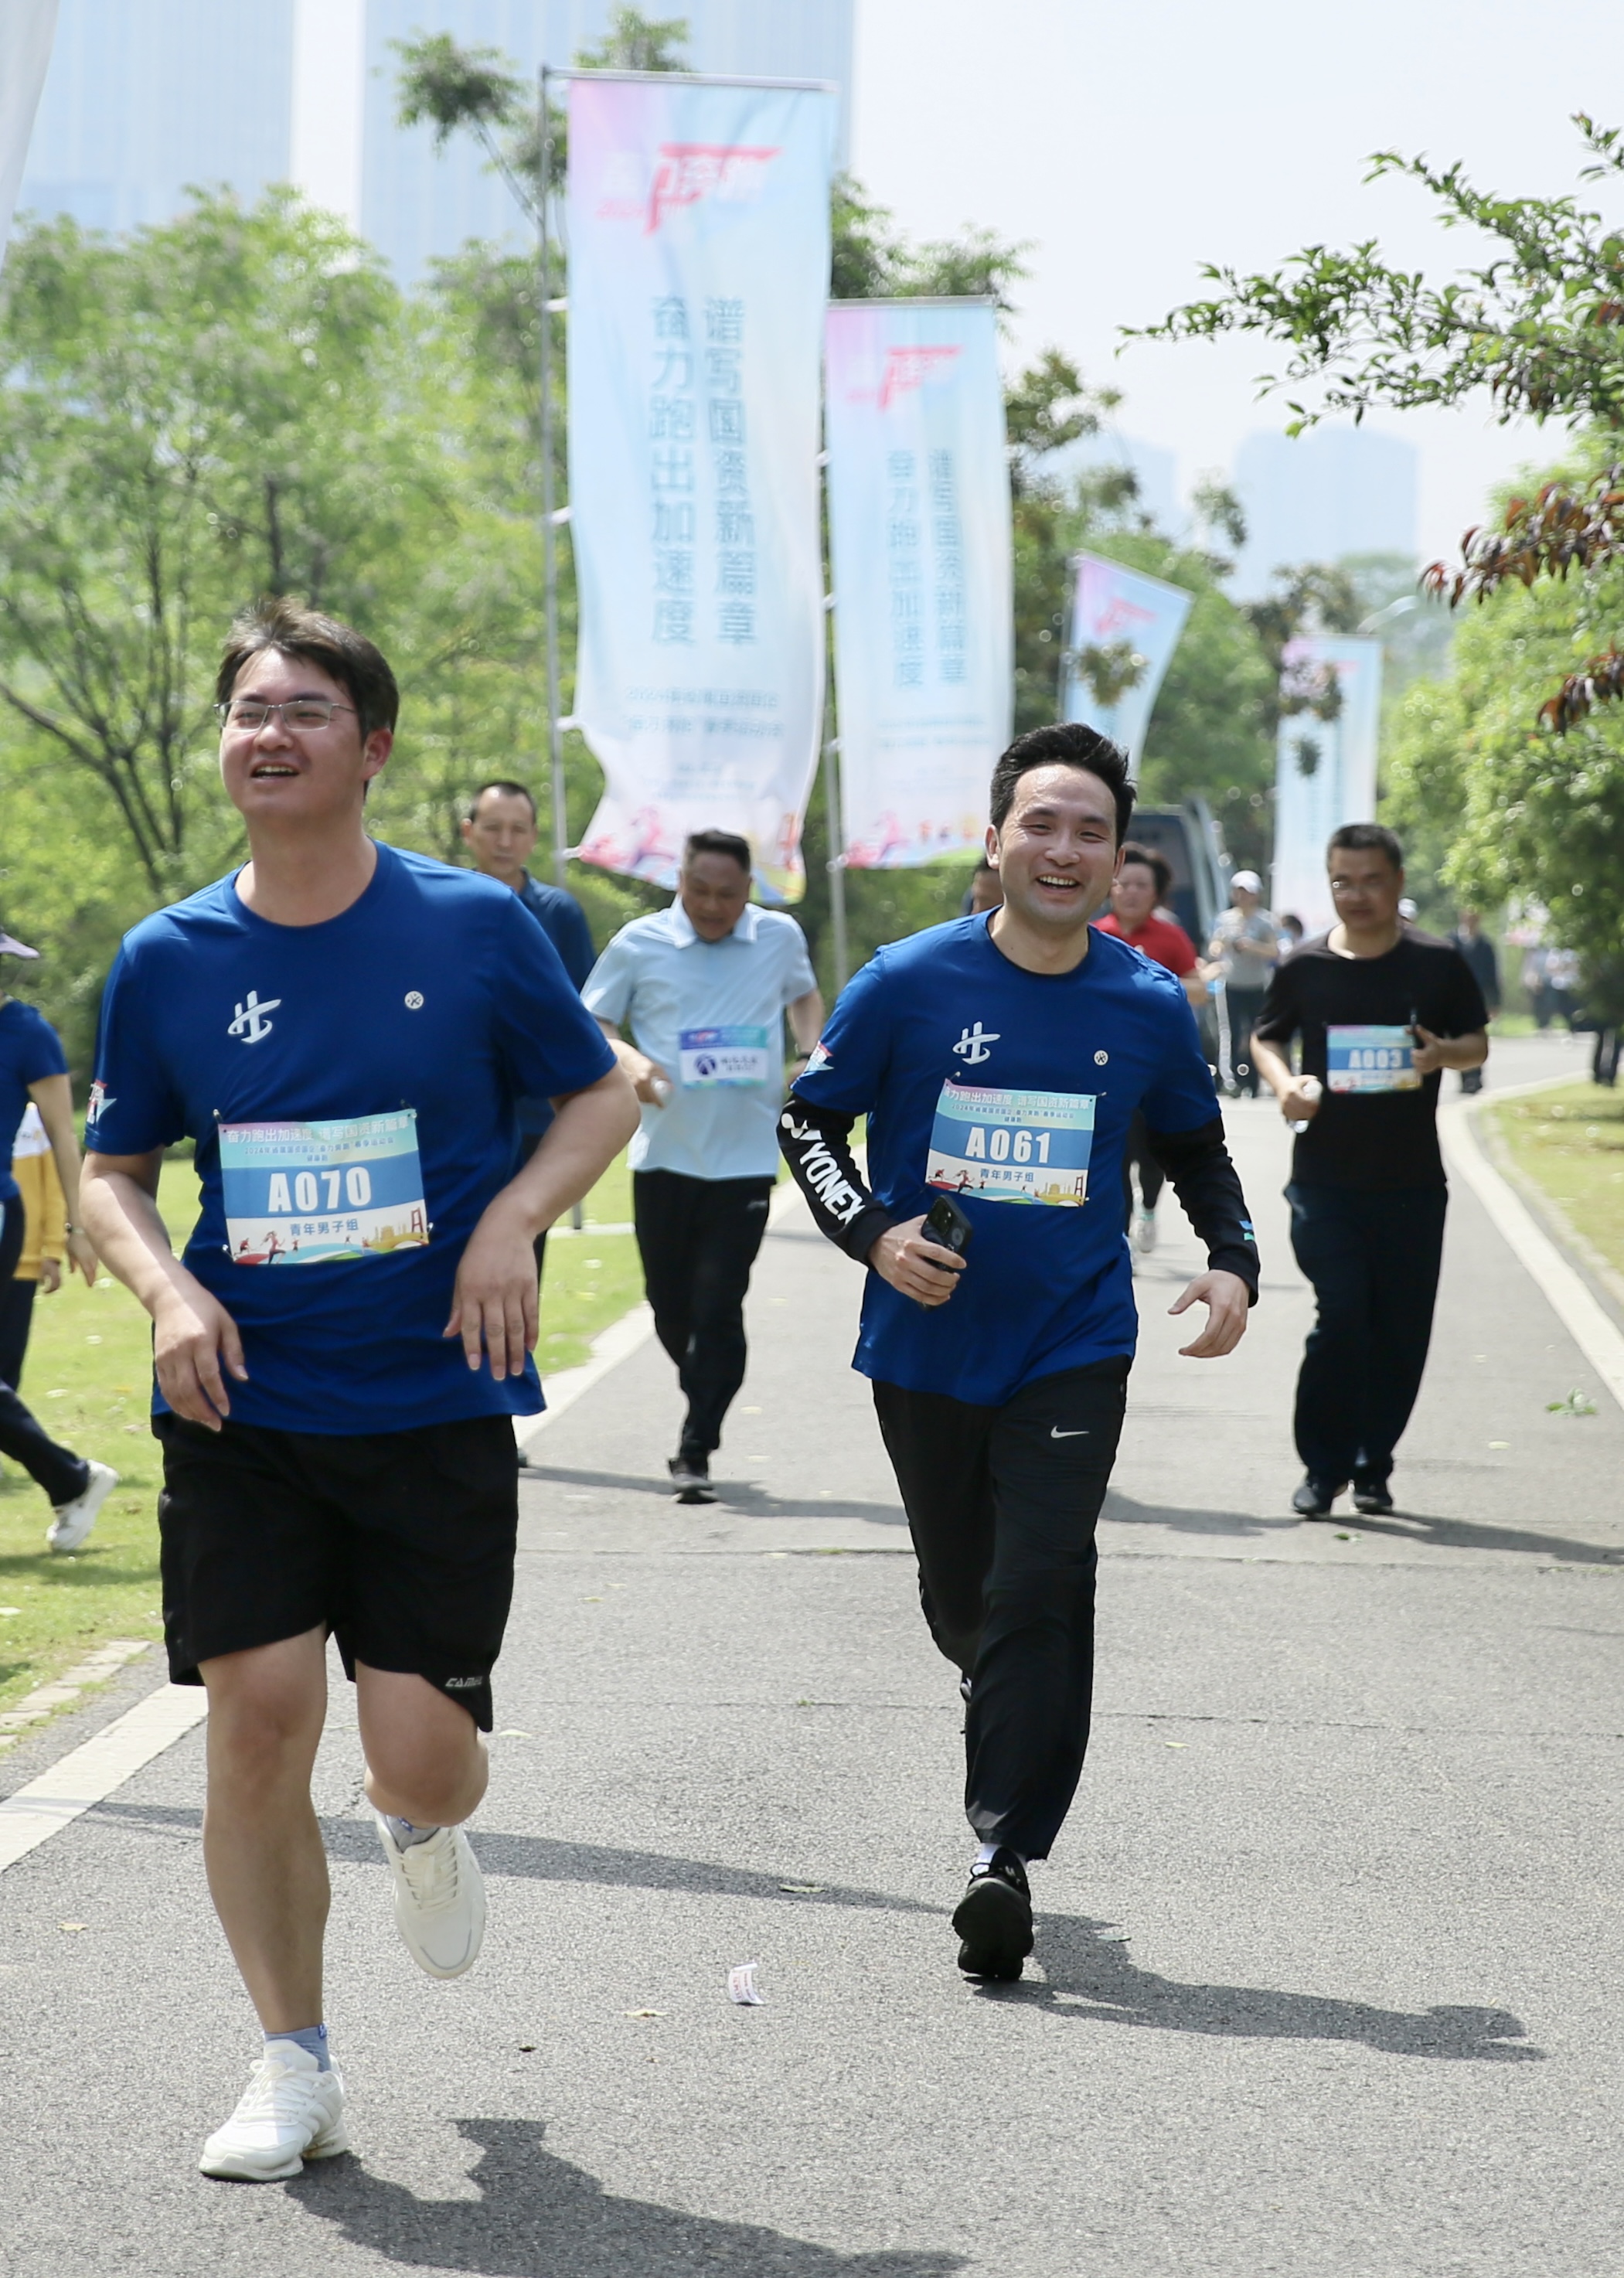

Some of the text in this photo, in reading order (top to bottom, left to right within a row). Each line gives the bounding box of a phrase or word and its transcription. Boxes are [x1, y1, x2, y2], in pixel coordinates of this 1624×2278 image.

[649, 295, 696, 647] 奋力跑出加速度
[227, 1115, 409, 1143] 奋力跑出加速度 谱写国资新篇章
[965, 1126, 1050, 1163] A061
[268, 1166, 372, 1213] A070
[799, 1142, 866, 1224] YONEX
[979, 1167, 1035, 1183] 青年男子组
[290, 1218, 359, 1237] 青年男子组
